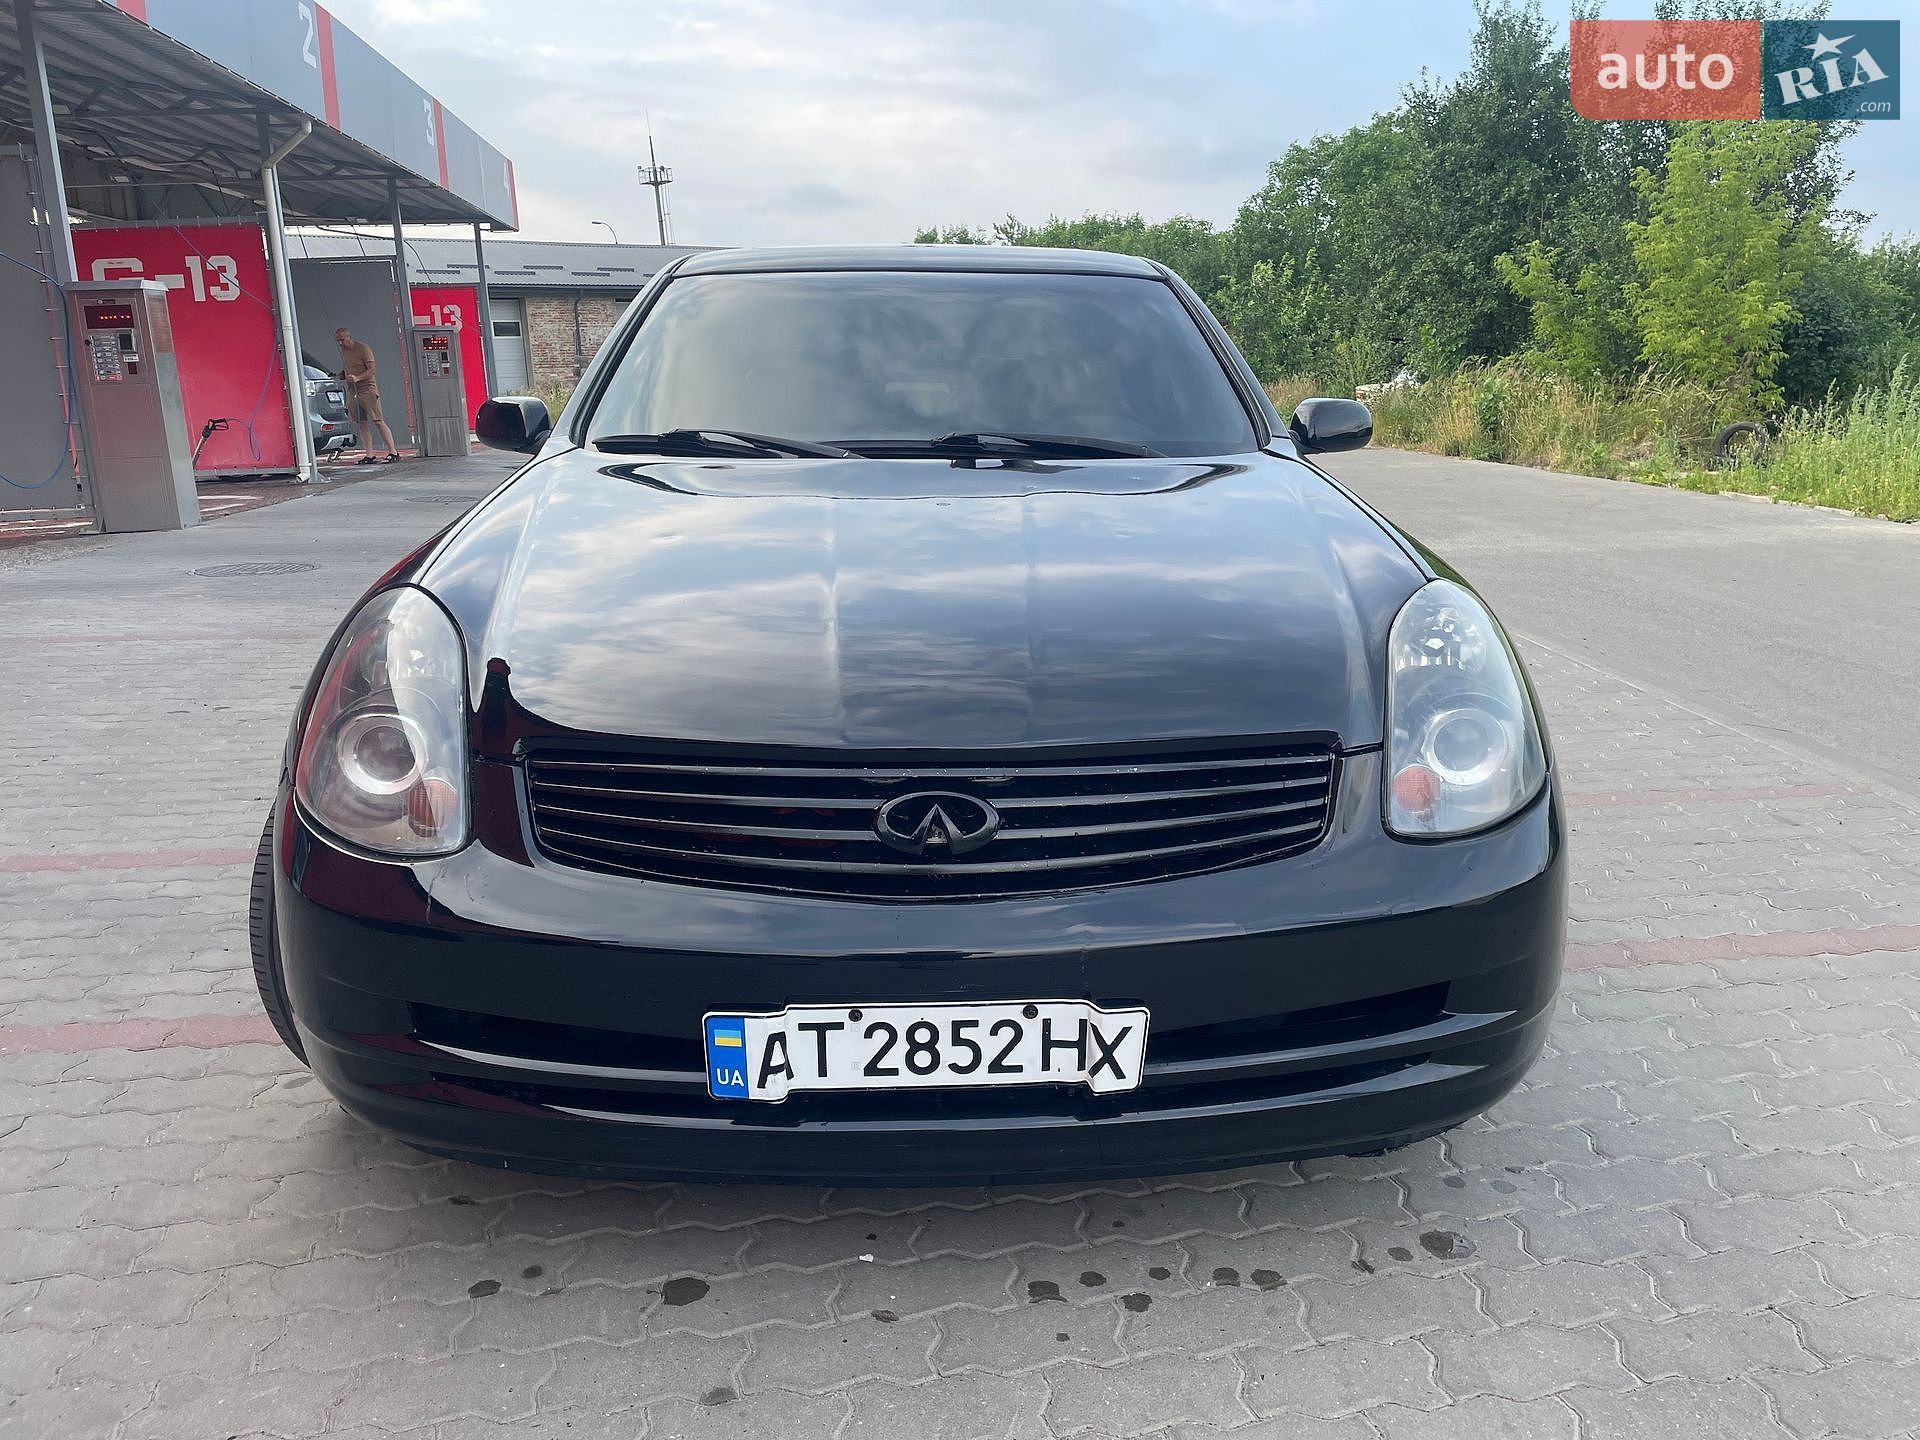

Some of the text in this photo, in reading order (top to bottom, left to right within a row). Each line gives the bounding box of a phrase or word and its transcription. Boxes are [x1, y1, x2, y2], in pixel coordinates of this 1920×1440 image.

[298, 4, 317, 69] 2
[423, 98, 435, 147] 3
[862, 1018, 1024, 1078] 2852
[1040, 1017, 1133, 1080] HX
[716, 1067, 745, 1088] UA
